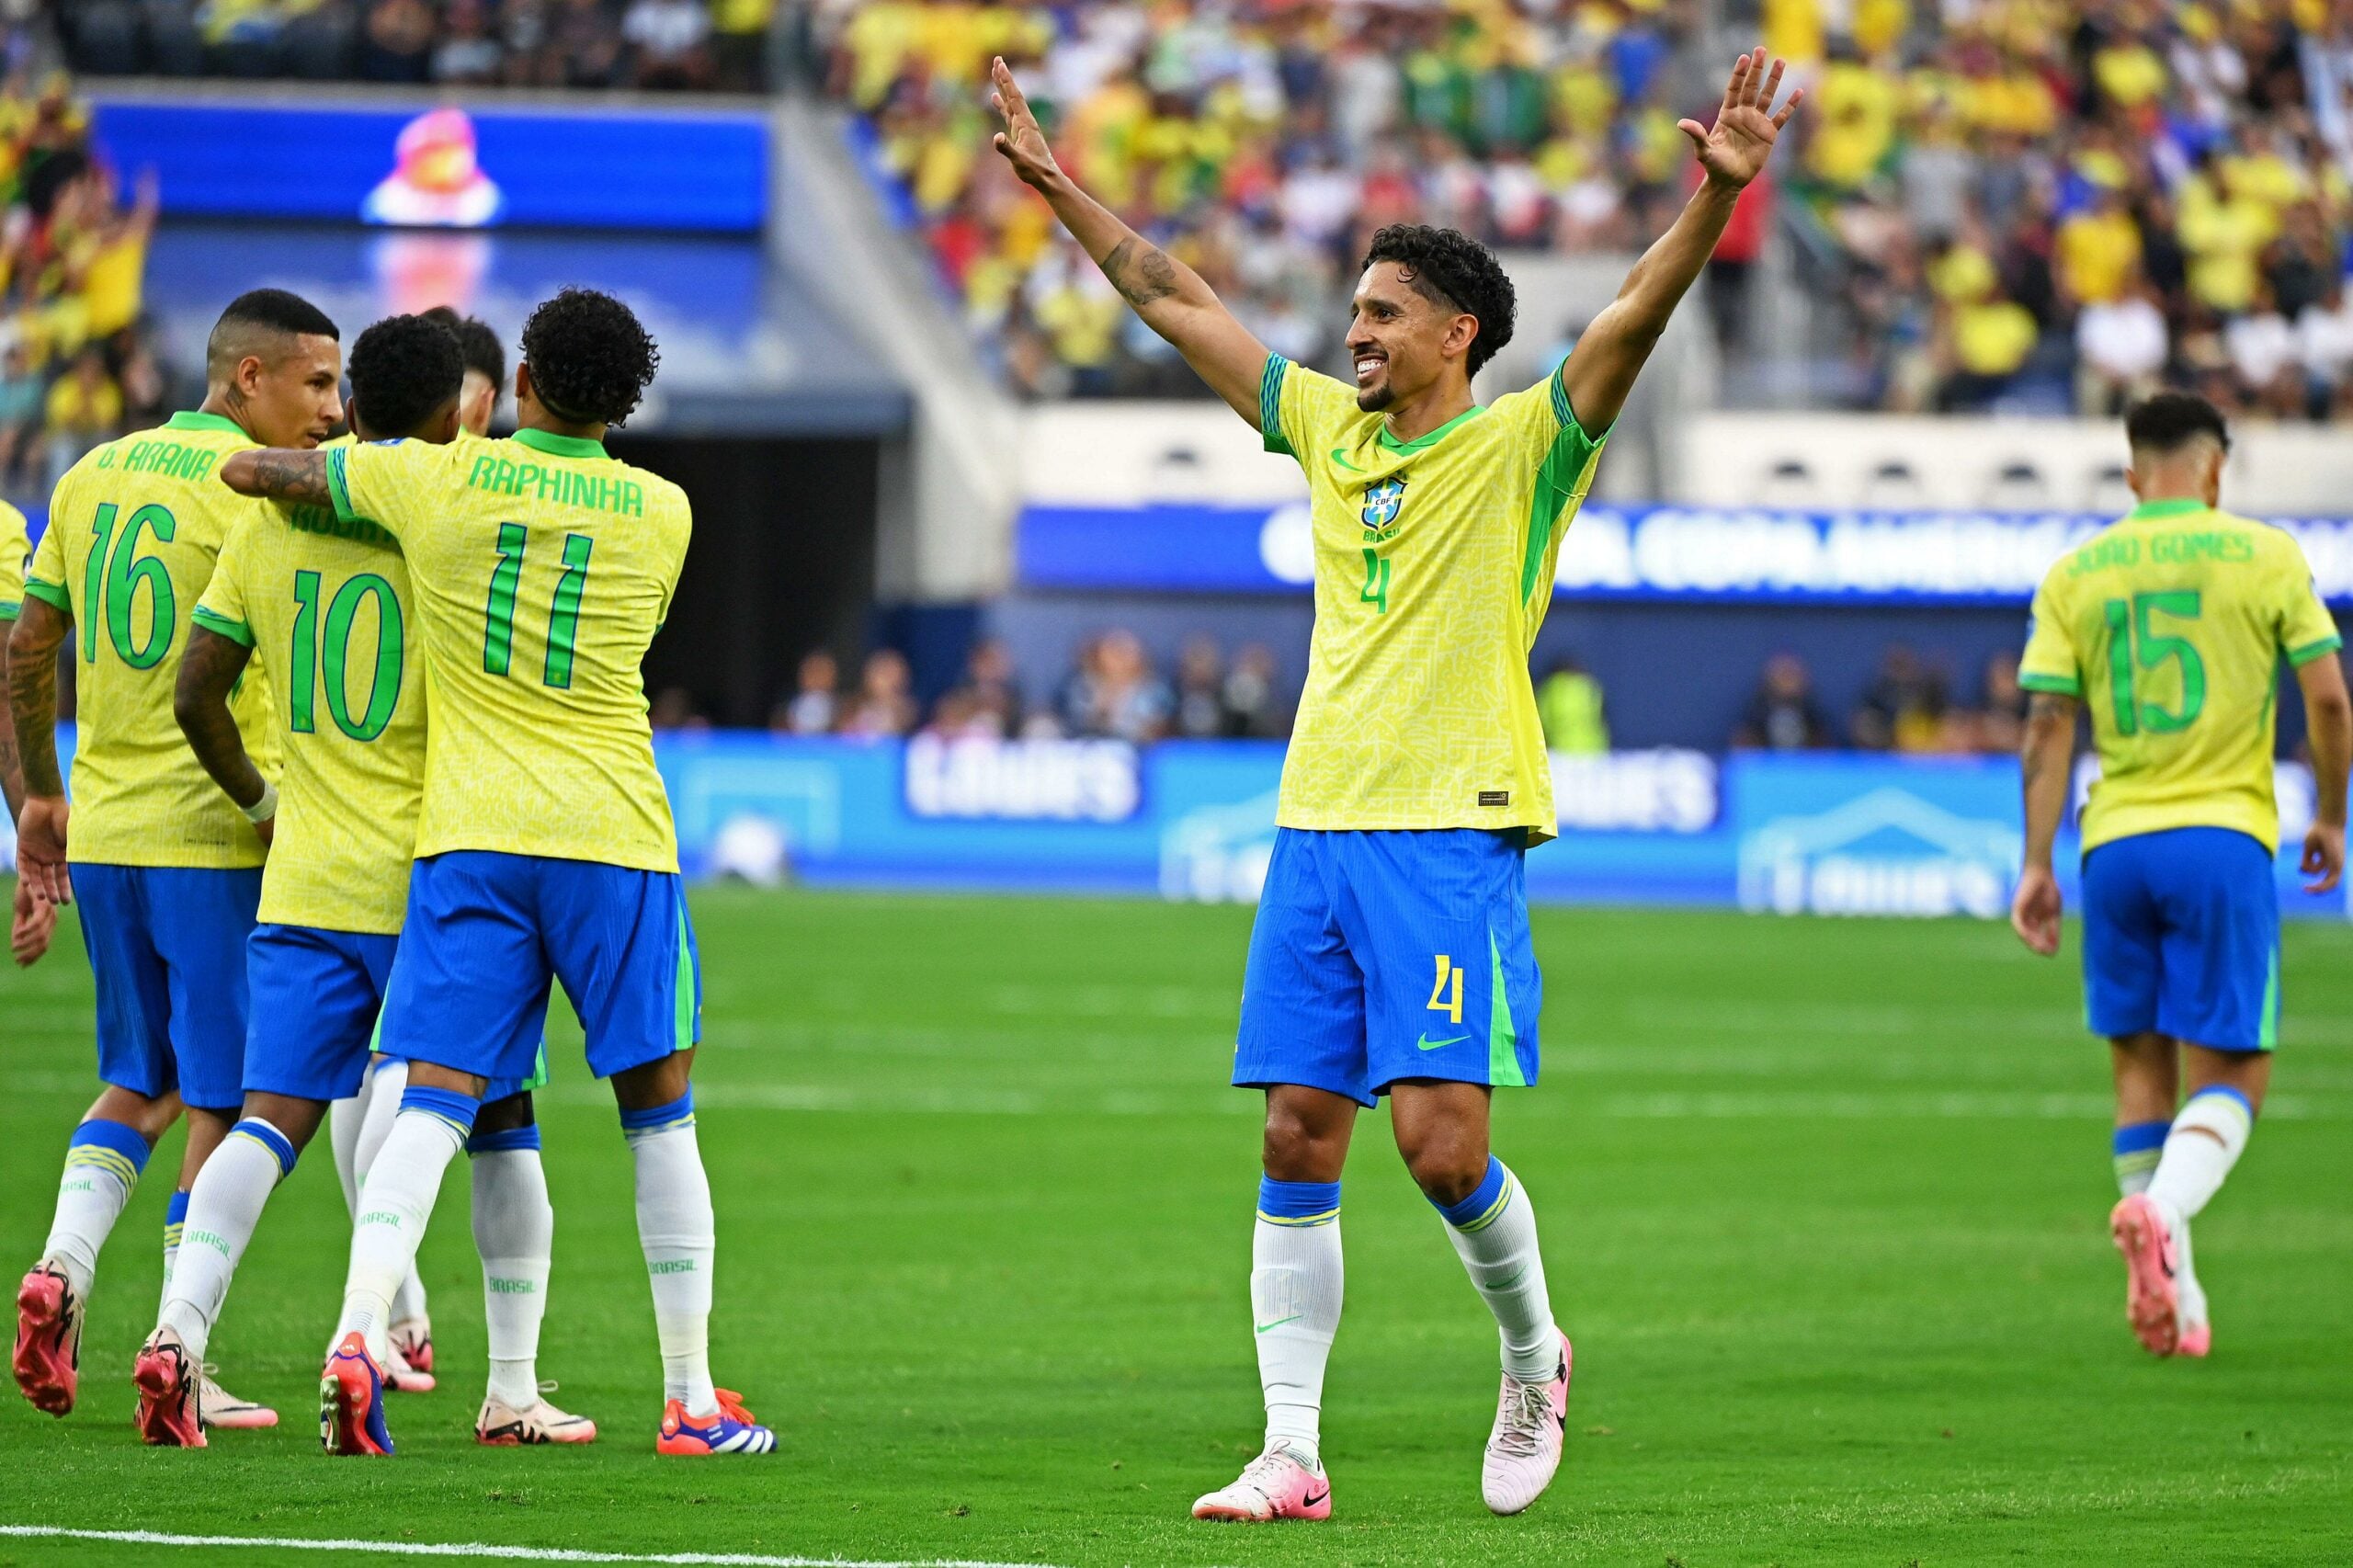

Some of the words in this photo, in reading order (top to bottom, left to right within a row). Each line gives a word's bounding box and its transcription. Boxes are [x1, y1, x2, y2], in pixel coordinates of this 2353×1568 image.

[123, 441, 218, 483] ARANA
[468, 456, 643, 518] RAPHINHA
[1374, 497, 1392, 506] CBF
[2150, 530, 2255, 564] GOMES
[84, 502, 176, 671] 16
[483, 521, 595, 690] 11
[1360, 548, 1391, 615] 4
[290, 569, 404, 743] 10
[2105, 587, 2208, 737] 15
[1426, 954, 1464, 1024] 4
[186, 1230, 232, 1262] BRASIL
[648, 1257, 699, 1275] BRASIL
[488, 1277, 538, 1294] BRASIL
